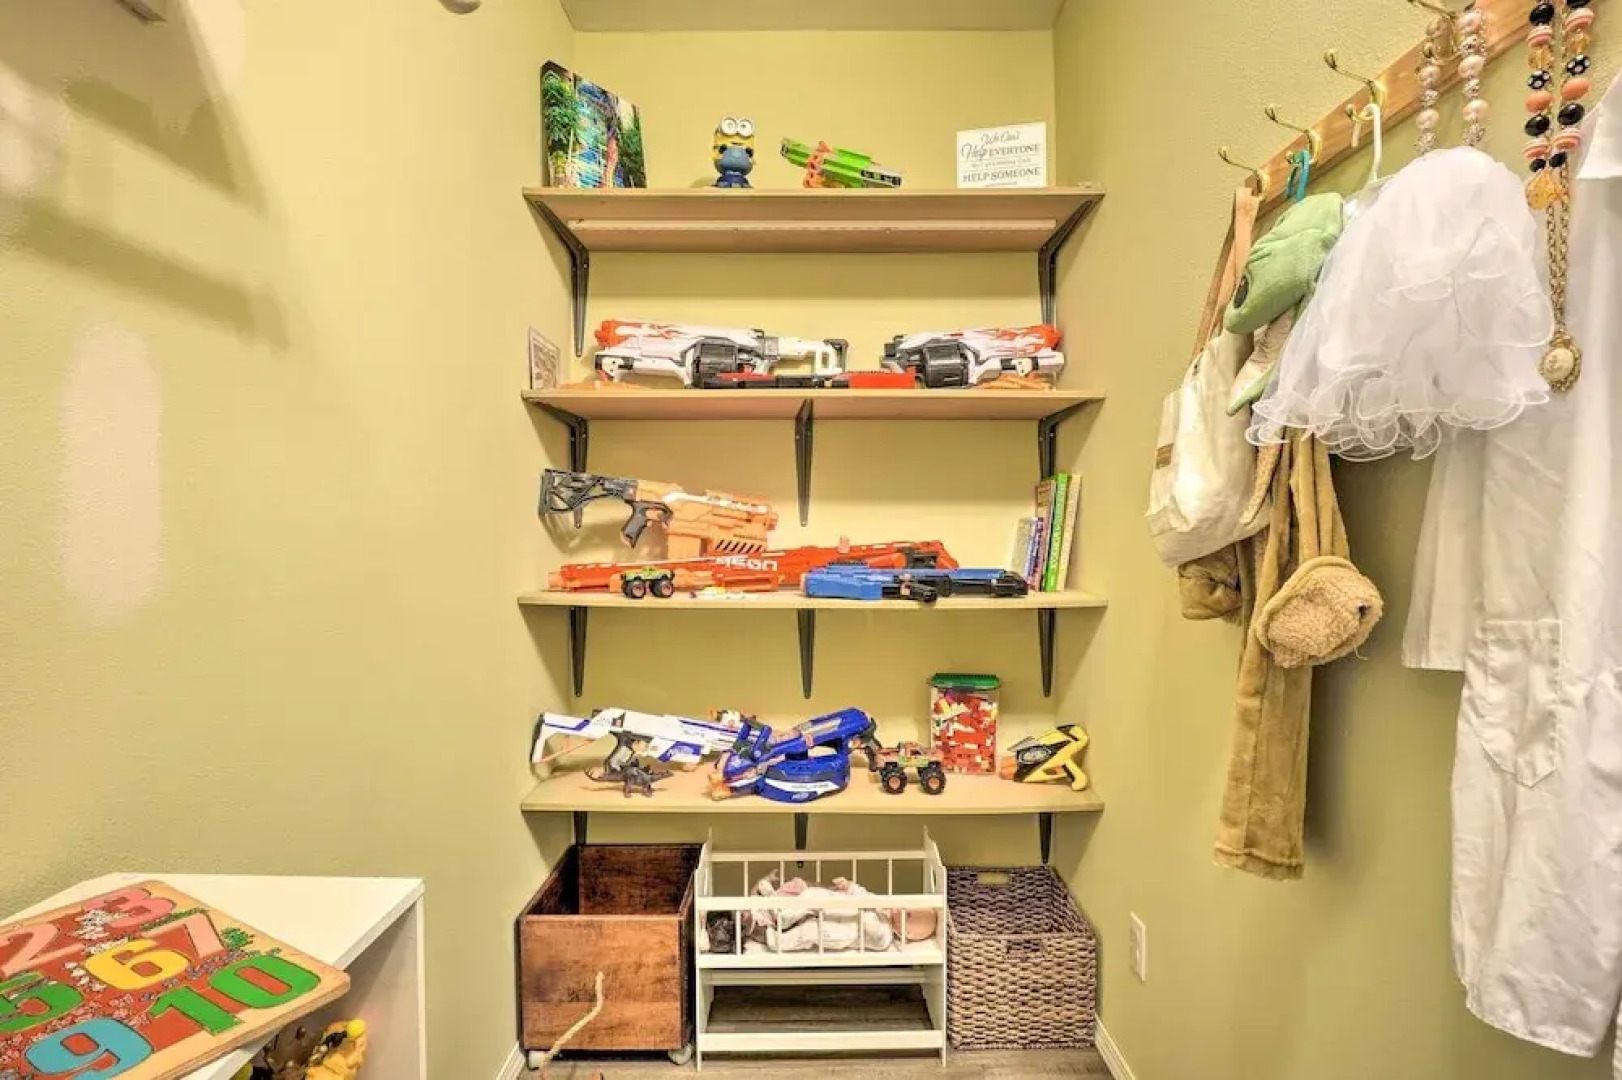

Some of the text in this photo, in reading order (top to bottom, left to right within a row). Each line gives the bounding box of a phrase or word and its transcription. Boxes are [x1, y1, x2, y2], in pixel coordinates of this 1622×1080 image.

[961, 143, 1040, 161] Help EVERYONE
[963, 167, 1041, 182] HELP SOMEONE
[0, 887, 176, 978] 2 3
[0, 912, 226, 1033] 5 6 7
[25, 954, 321, 1080] 9 10
